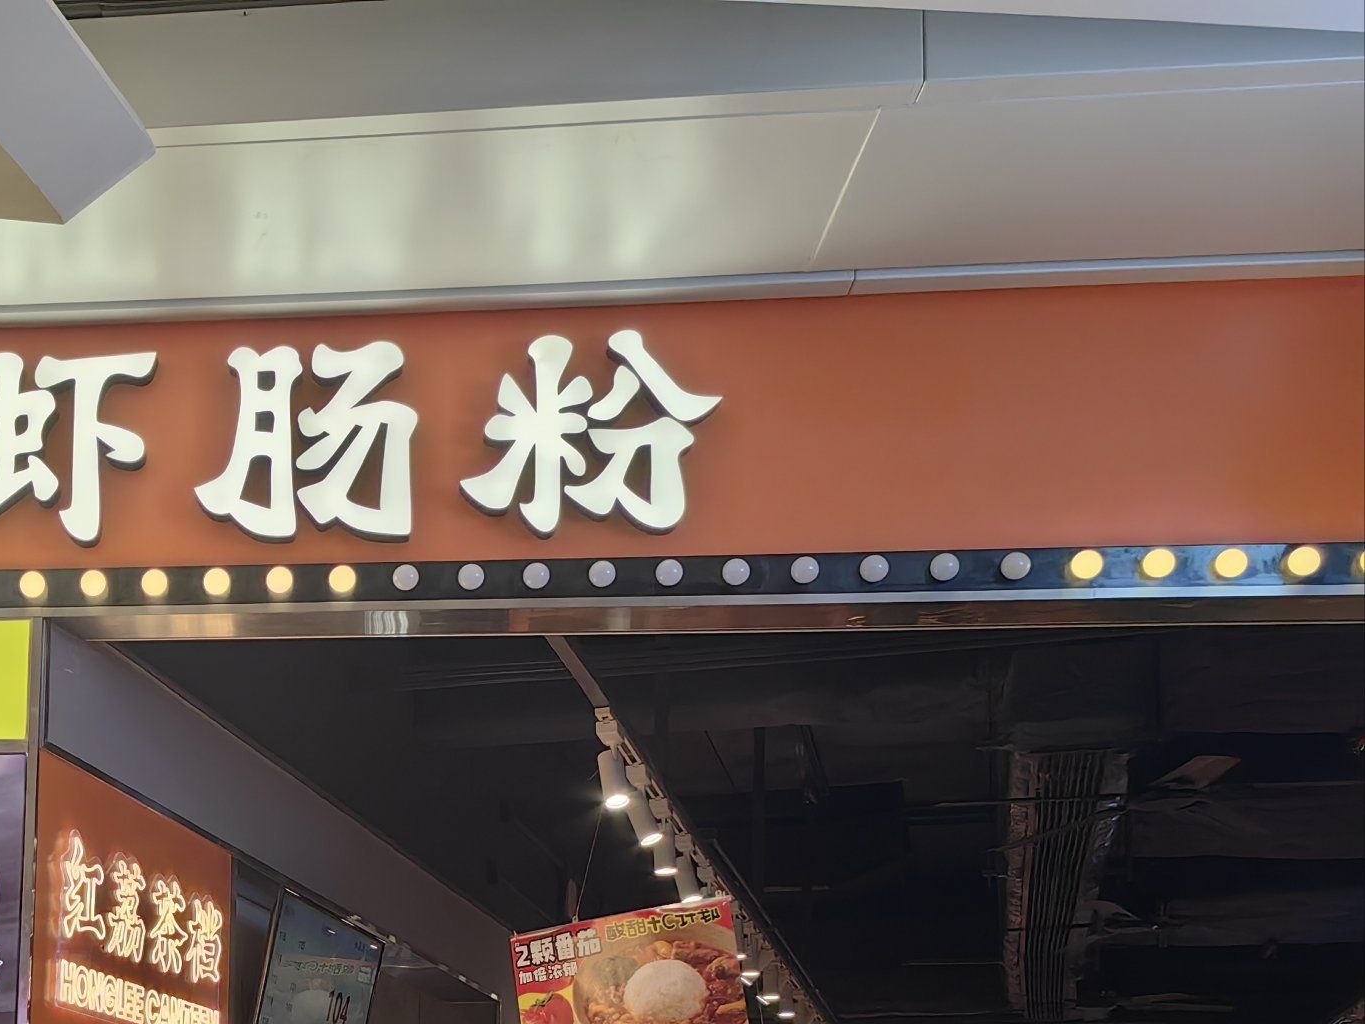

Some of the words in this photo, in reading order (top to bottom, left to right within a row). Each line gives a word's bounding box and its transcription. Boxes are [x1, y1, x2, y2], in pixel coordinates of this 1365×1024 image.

[515, 929, 602, 967] 2颗番茄
[60, 959, 144, 1024] HONGLEE
